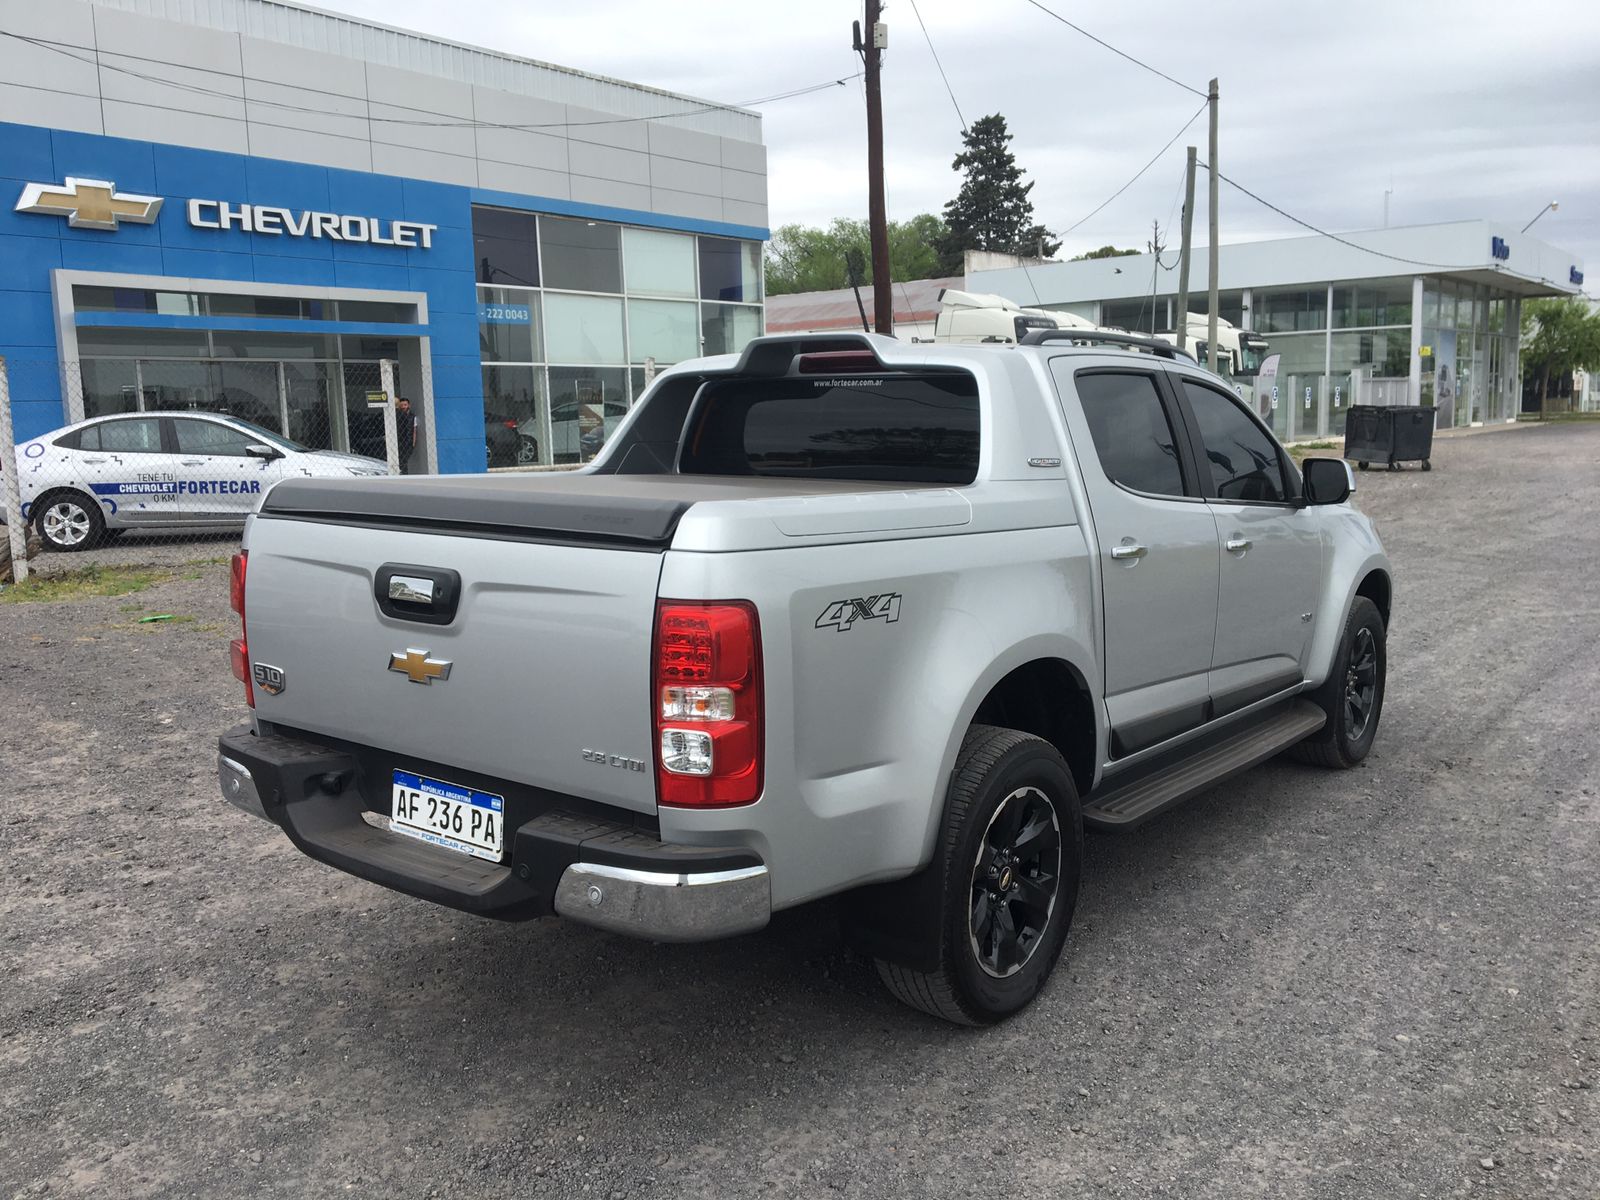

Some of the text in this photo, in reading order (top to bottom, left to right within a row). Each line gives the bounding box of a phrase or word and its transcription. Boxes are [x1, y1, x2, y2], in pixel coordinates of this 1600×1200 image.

[188, 198, 438, 248] CHEVROLET
[486, 308, 504, 319] 222
[505, 309, 529, 320] 0043
[813, 379, 883, 387] www.fortecar.com.ar
[162, 472, 174, 482] TU
[119, 480, 261, 494] CHEVROLET FORTECAR
[162, 494, 176, 503] KM
[255, 665, 281, 684] S10
[420, 783, 472, 804] REPÚBLICA ARGENTINA
[397, 789, 495, 844] AF 236 PA
[421, 832, 459, 849] FORTECAR
